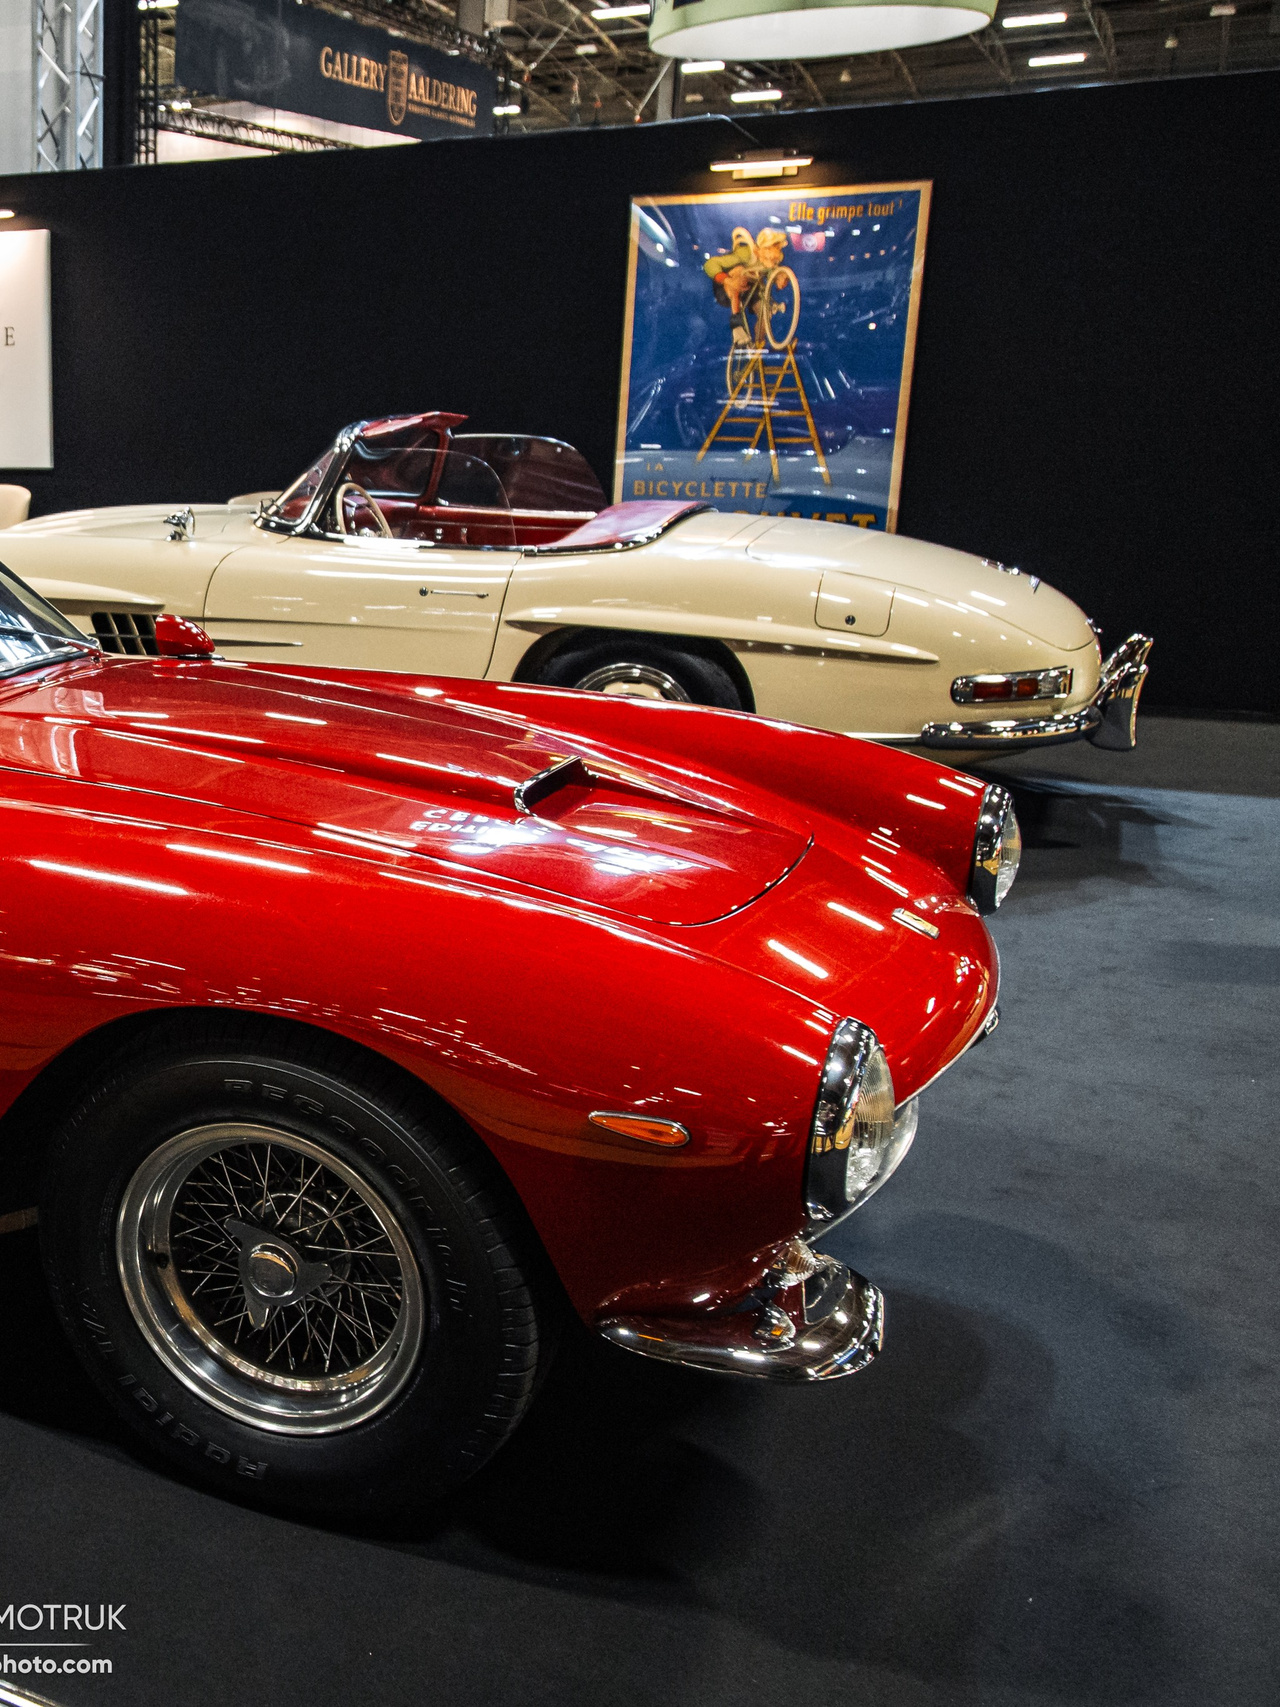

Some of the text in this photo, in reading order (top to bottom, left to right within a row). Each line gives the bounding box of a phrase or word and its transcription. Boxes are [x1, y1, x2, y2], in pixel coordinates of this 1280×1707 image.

[320, 46, 388, 92] GALLERY
[408, 72, 478, 118] AALDERING
[788, 202, 815, 222] Elle
[817, 203, 864, 226] grimpe
[633, 479, 767, 499] BICYCLETTE
[117, 1373, 268, 1480] Radial
